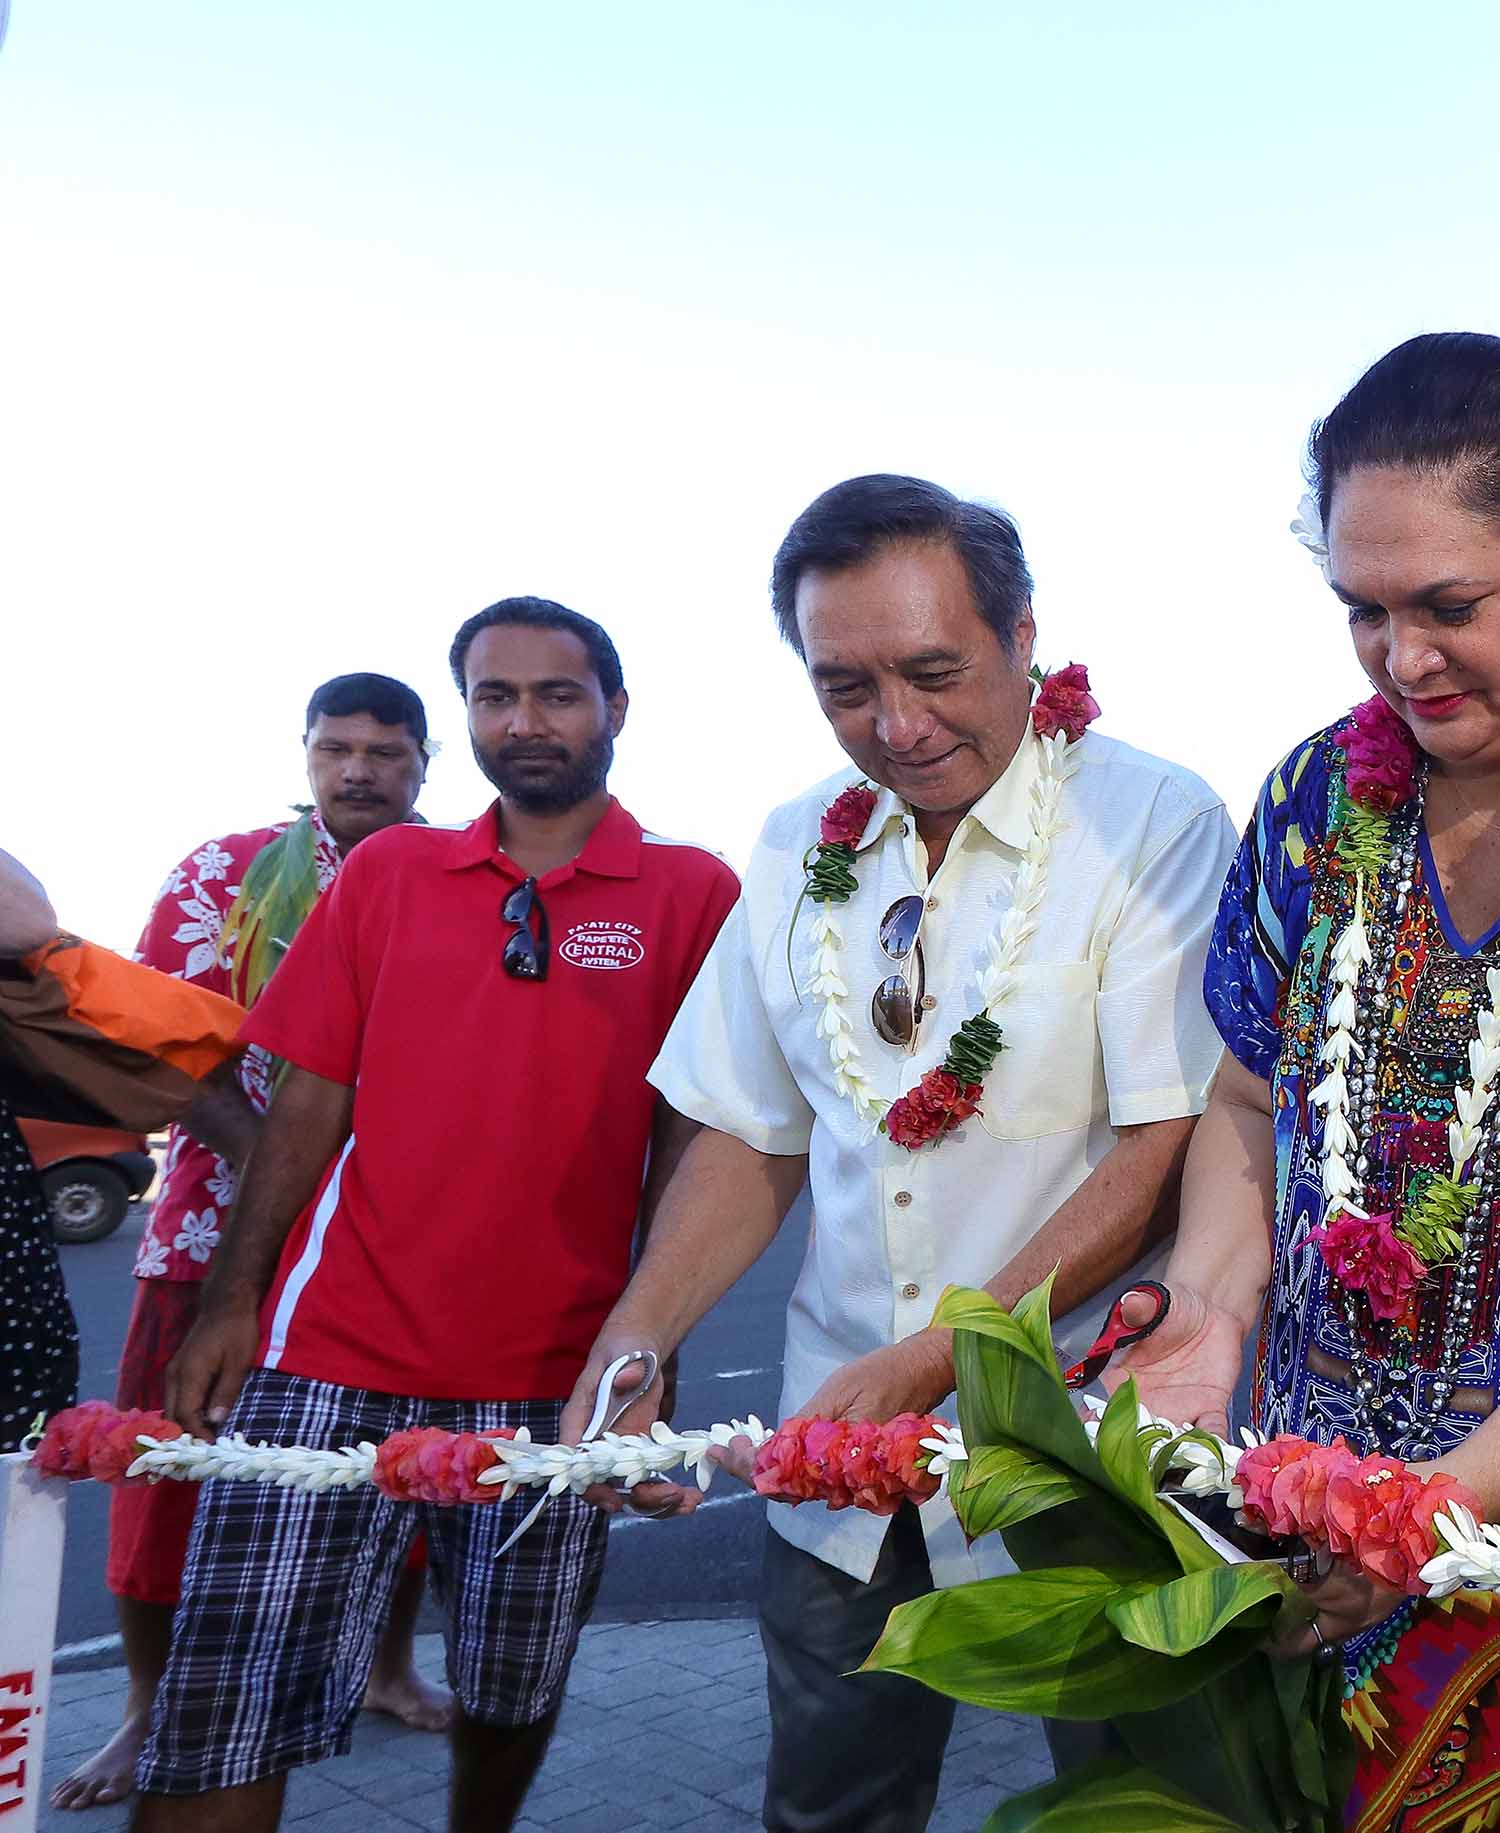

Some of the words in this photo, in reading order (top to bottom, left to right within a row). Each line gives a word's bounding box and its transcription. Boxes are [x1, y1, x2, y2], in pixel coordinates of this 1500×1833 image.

[614, 922, 643, 935] CITY
[565, 943, 637, 960] CENTRAL
[581, 957, 620, 967] SYSTEM
